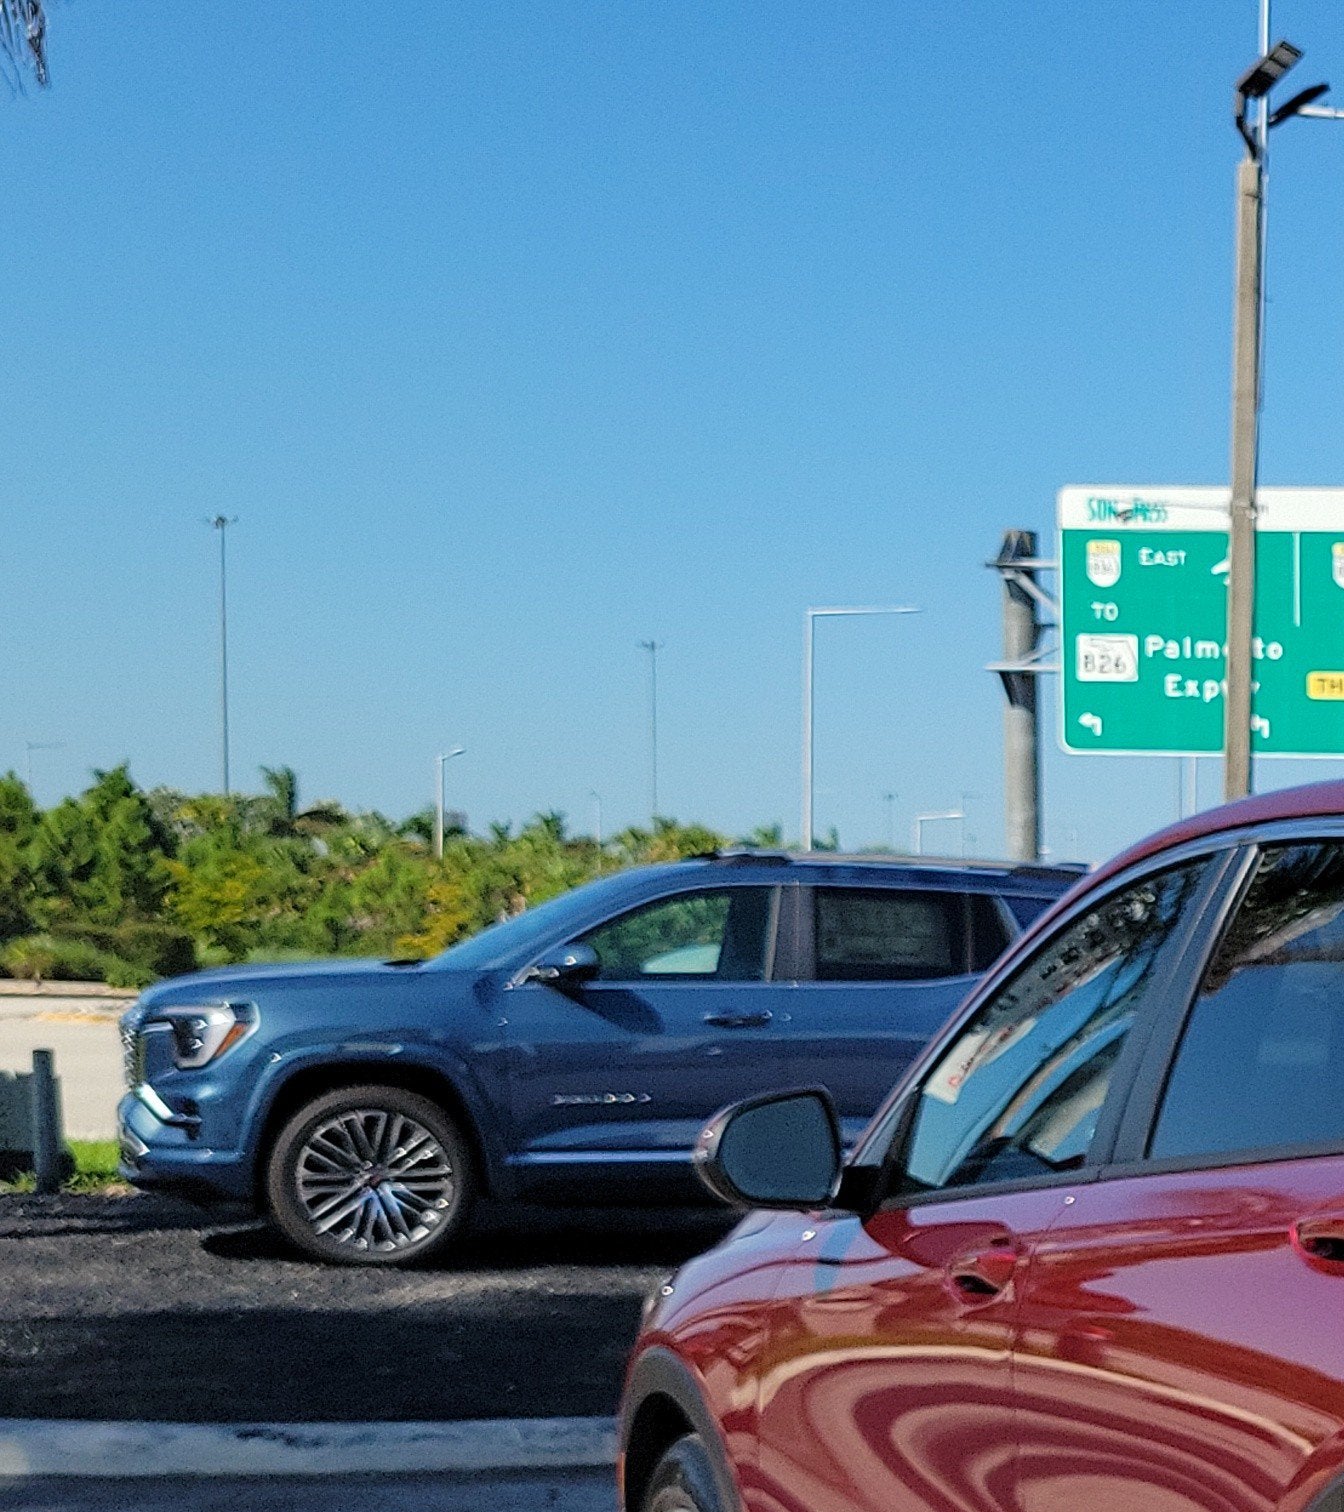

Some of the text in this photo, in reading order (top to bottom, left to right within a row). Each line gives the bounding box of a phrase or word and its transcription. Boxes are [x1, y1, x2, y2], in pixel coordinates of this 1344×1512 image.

[1138, 547, 1187, 567] EAST
[1091, 601, 1118, 621] TO
[1144, 634, 1284, 660] Palmto
[1084, 654, 1126, 674] 826
[1164, 673, 1260, 703] Exp
